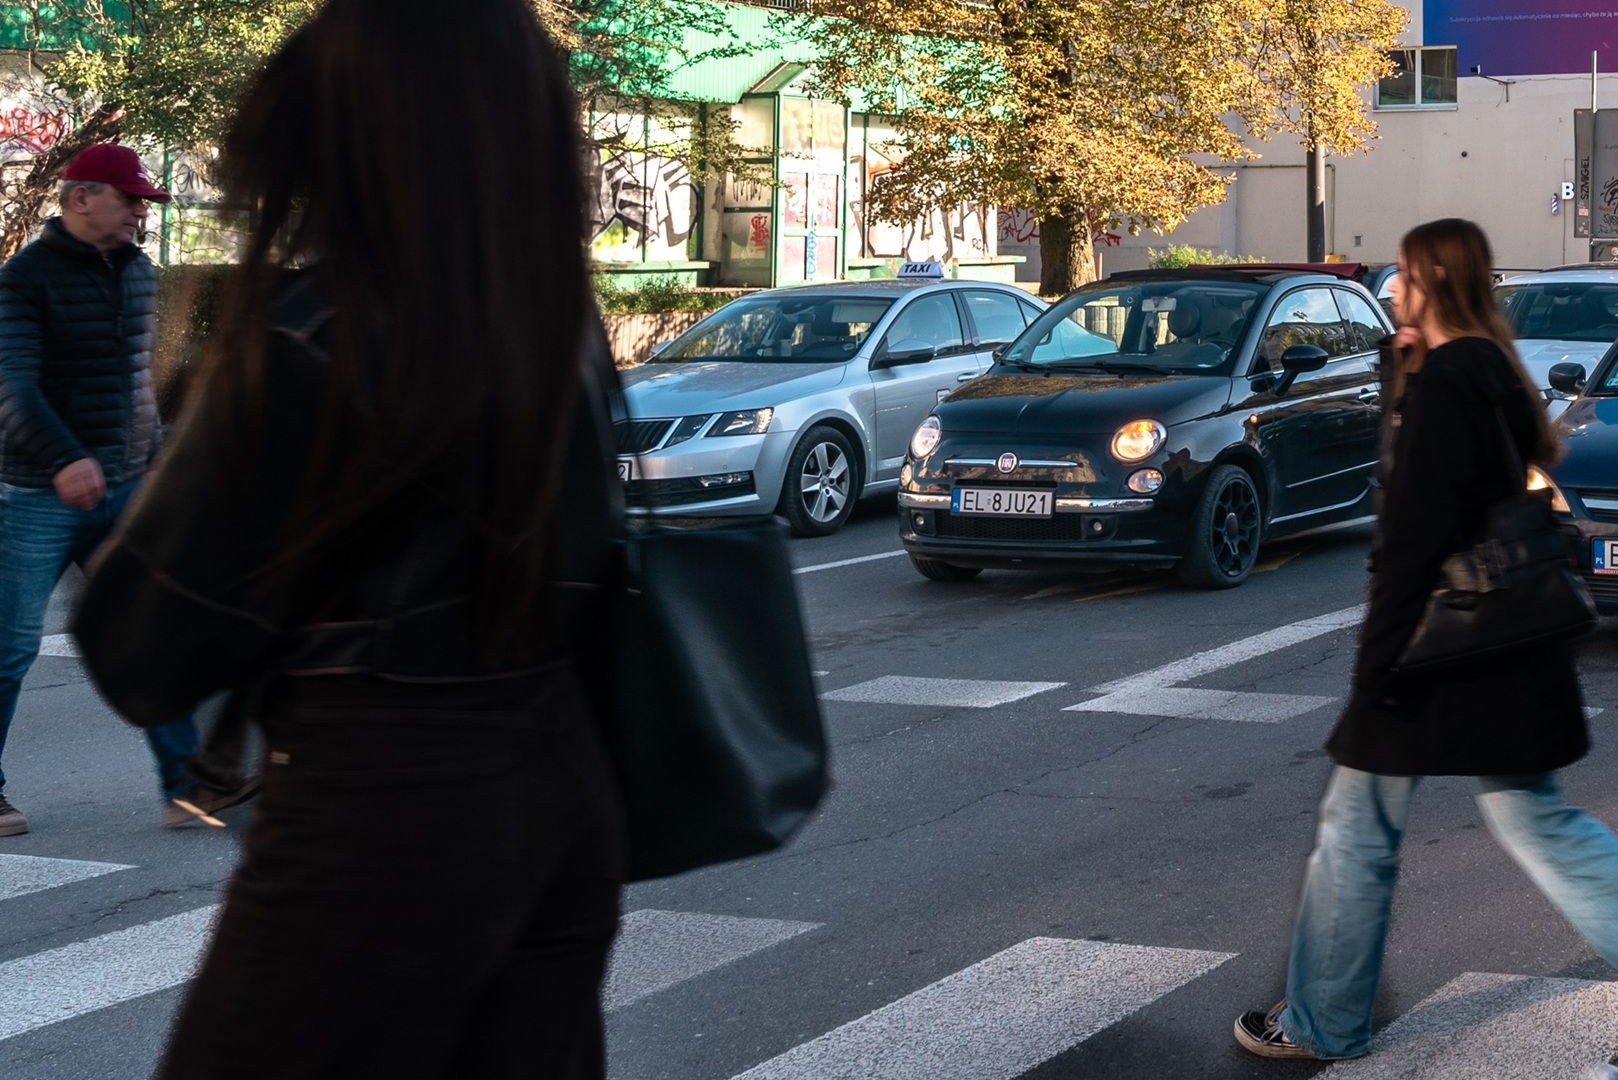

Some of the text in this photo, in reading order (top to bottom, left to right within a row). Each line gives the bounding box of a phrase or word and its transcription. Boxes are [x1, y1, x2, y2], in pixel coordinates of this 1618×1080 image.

[904, 263, 932, 274] TAXI
[964, 491, 984, 512] EL
[992, 492, 1046, 514] 8JU21
[1595, 557, 1604, 565] PL
